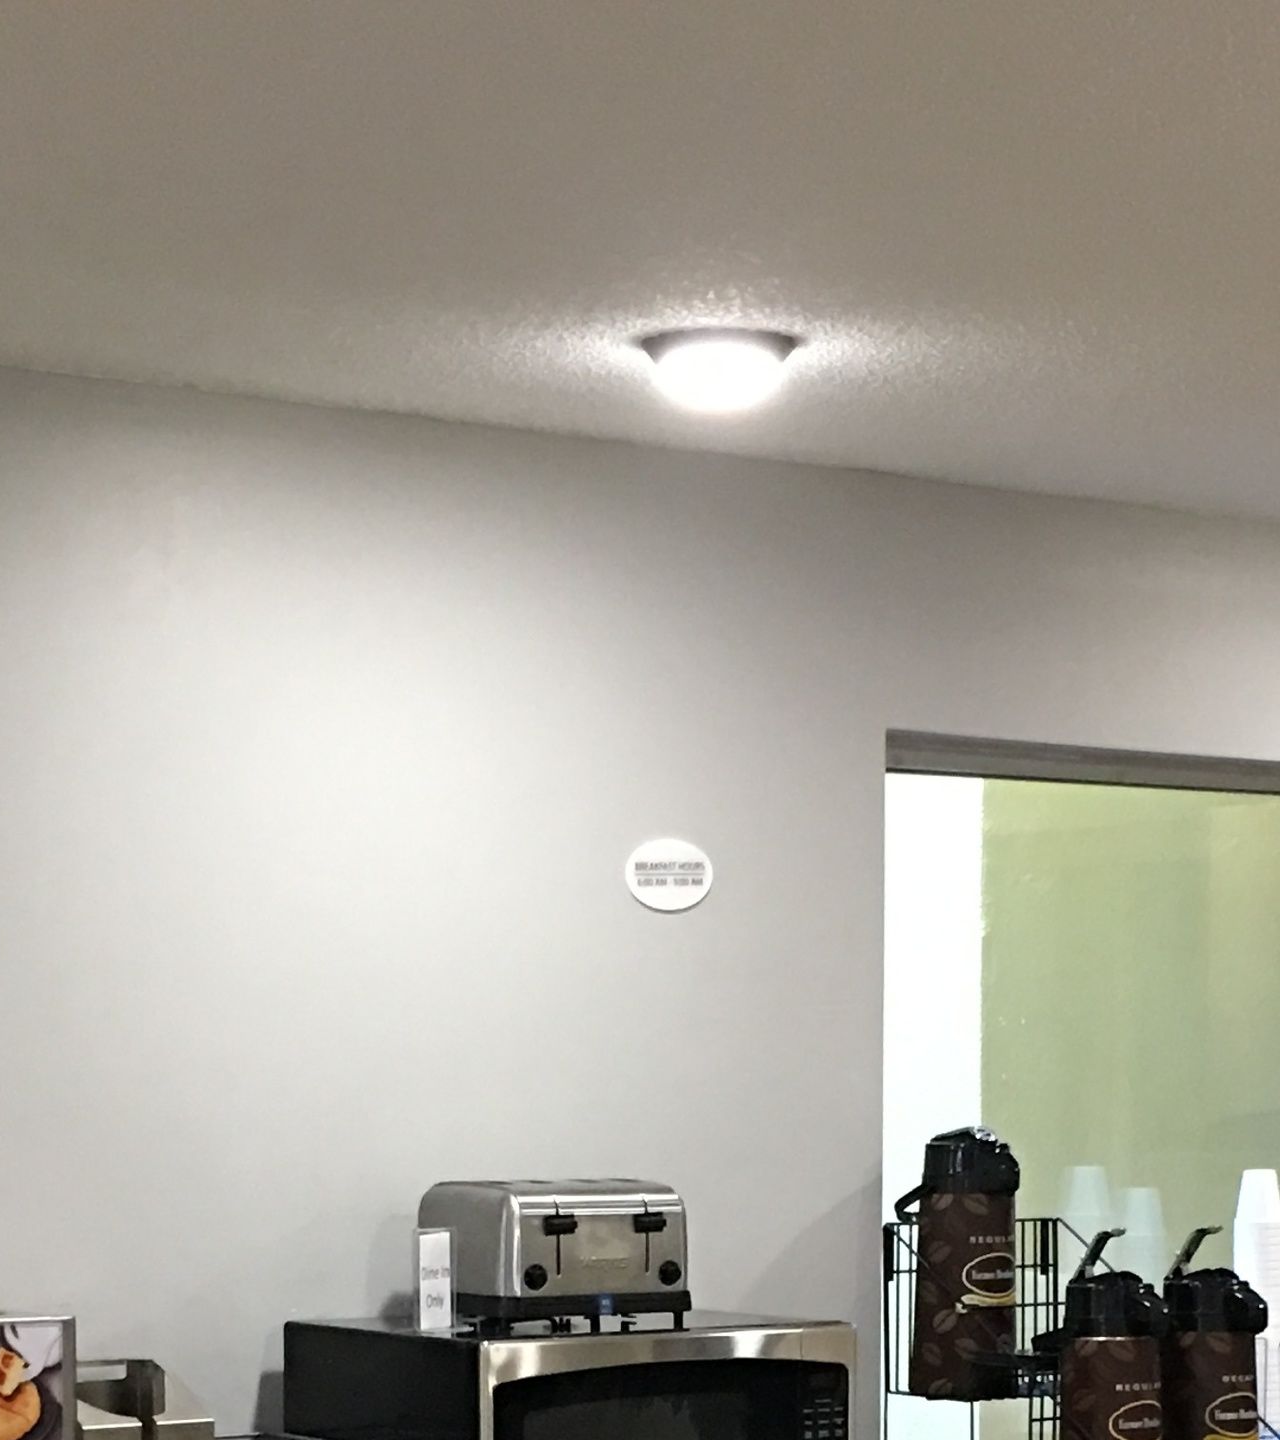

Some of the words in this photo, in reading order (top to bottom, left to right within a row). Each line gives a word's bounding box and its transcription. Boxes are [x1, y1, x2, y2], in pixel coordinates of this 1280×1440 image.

[634, 862, 677, 871] BREAKFAST
[969, 1235, 1015, 1244] REGULA
[426, 1293, 444, 1310] Only
[1115, 1382, 1161, 1392] REGULA
